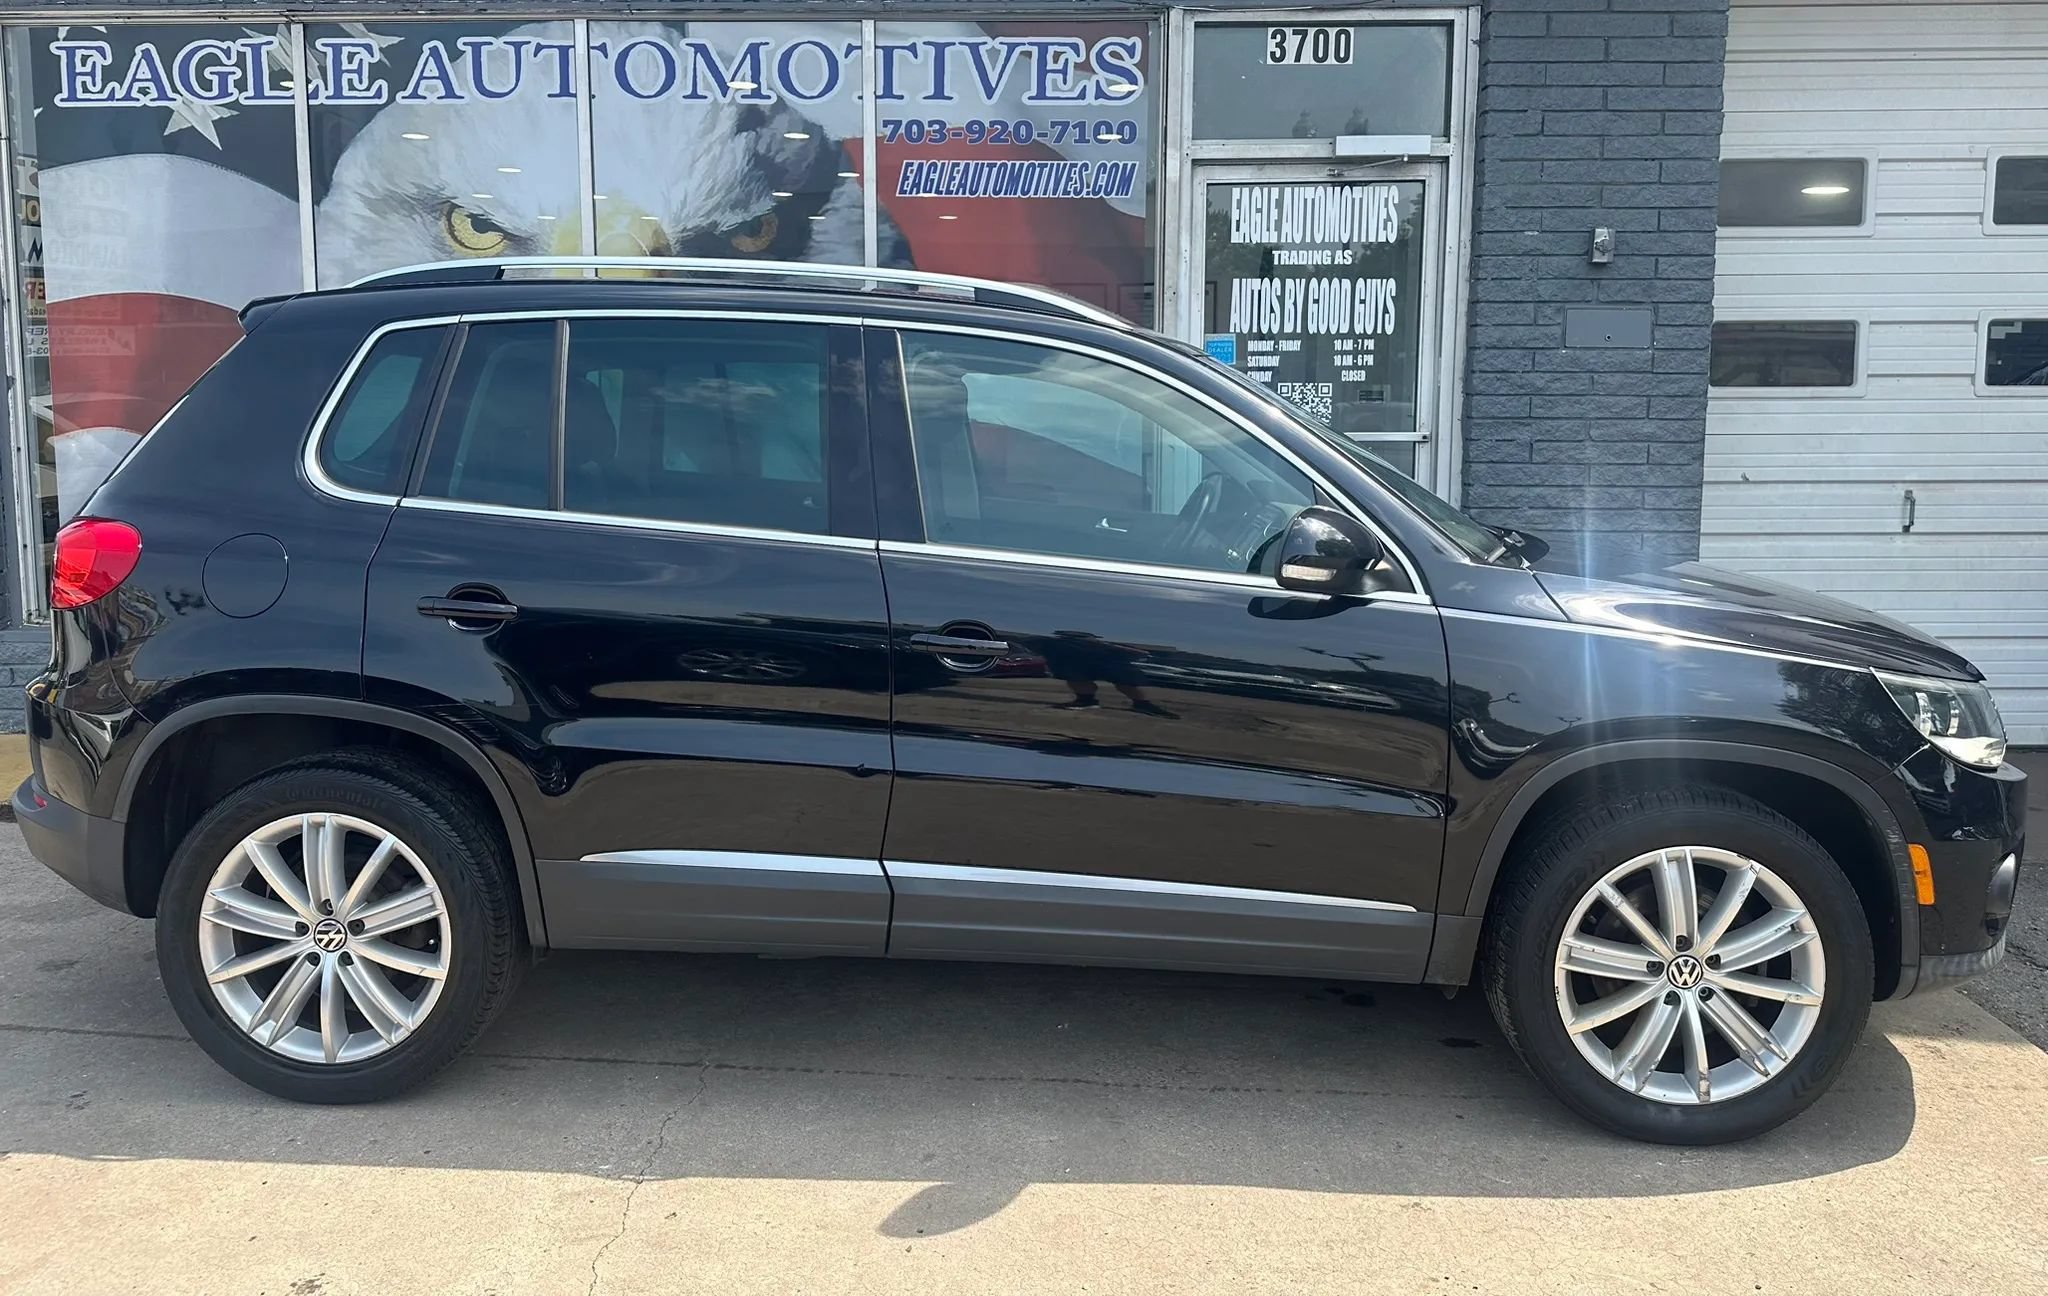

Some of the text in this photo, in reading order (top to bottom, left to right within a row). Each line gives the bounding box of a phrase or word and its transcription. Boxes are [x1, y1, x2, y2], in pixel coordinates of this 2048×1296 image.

[1269, 28, 1351, 64] 3700
[51, 36, 1144, 106] EAGLE AUTOMOTIVES
[881, 118, 1138, 146] 703-920-7100
[896, 160, 1138, 199] EAGLEAUTOMOTIVES.COM
[1231, 185, 1399, 244] EAGLE AUTOMOTIVES
[1272, 250, 1353, 265] TRADING AS
[1229, 277, 1397, 335] AUTOS BY GOOD GUYS
[1247, 340, 1275, 352] MONDAY
[1278, 339, 1302, 351] FRIDAY
[1333, 339, 1342, 351] 10
[1342, 339, 1353, 351] AM
[1357, 338, 1362, 351] 7
[1363, 338, 1375, 350] PM
[1247, 355, 1280, 367] SATURDAY
[1333, 354, 1342, 366] 10
[1342, 354, 1353, 366] AM
[1357, 354, 1363, 366] 6
[1363, 354, 1374, 366] PM
[1341, 369, 1366, 381] CLOSED
[1668, 956, 1702, 988] VW
